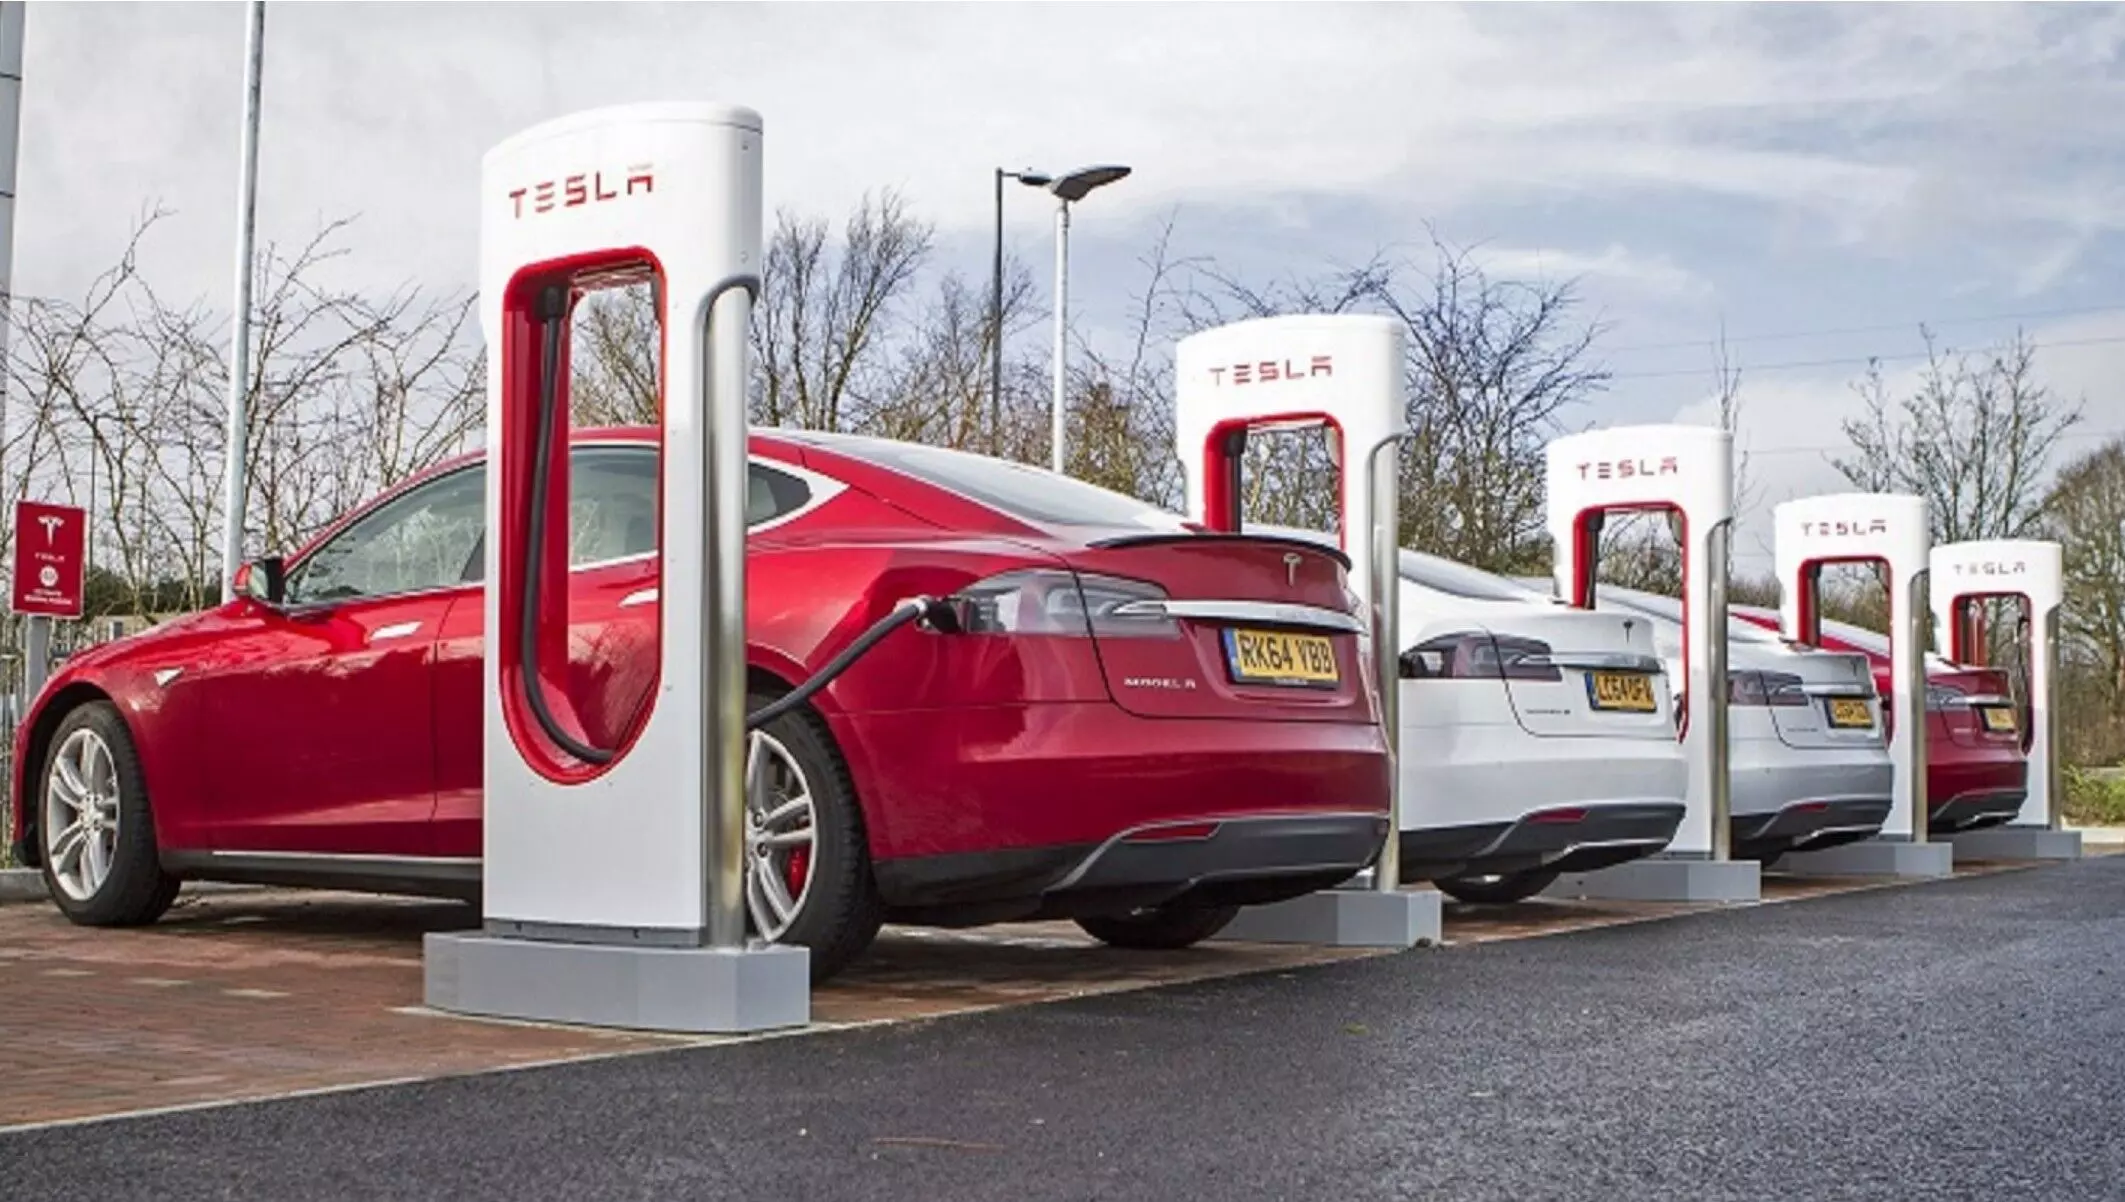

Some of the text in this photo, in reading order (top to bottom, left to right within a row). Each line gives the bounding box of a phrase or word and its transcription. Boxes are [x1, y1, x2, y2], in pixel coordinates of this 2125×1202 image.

[509, 162, 653, 219] TESLA
[1209, 356, 1332, 387] TESLA
[1576, 456, 1677, 480] TESLA
[1801, 519, 1887, 537] TESLA
